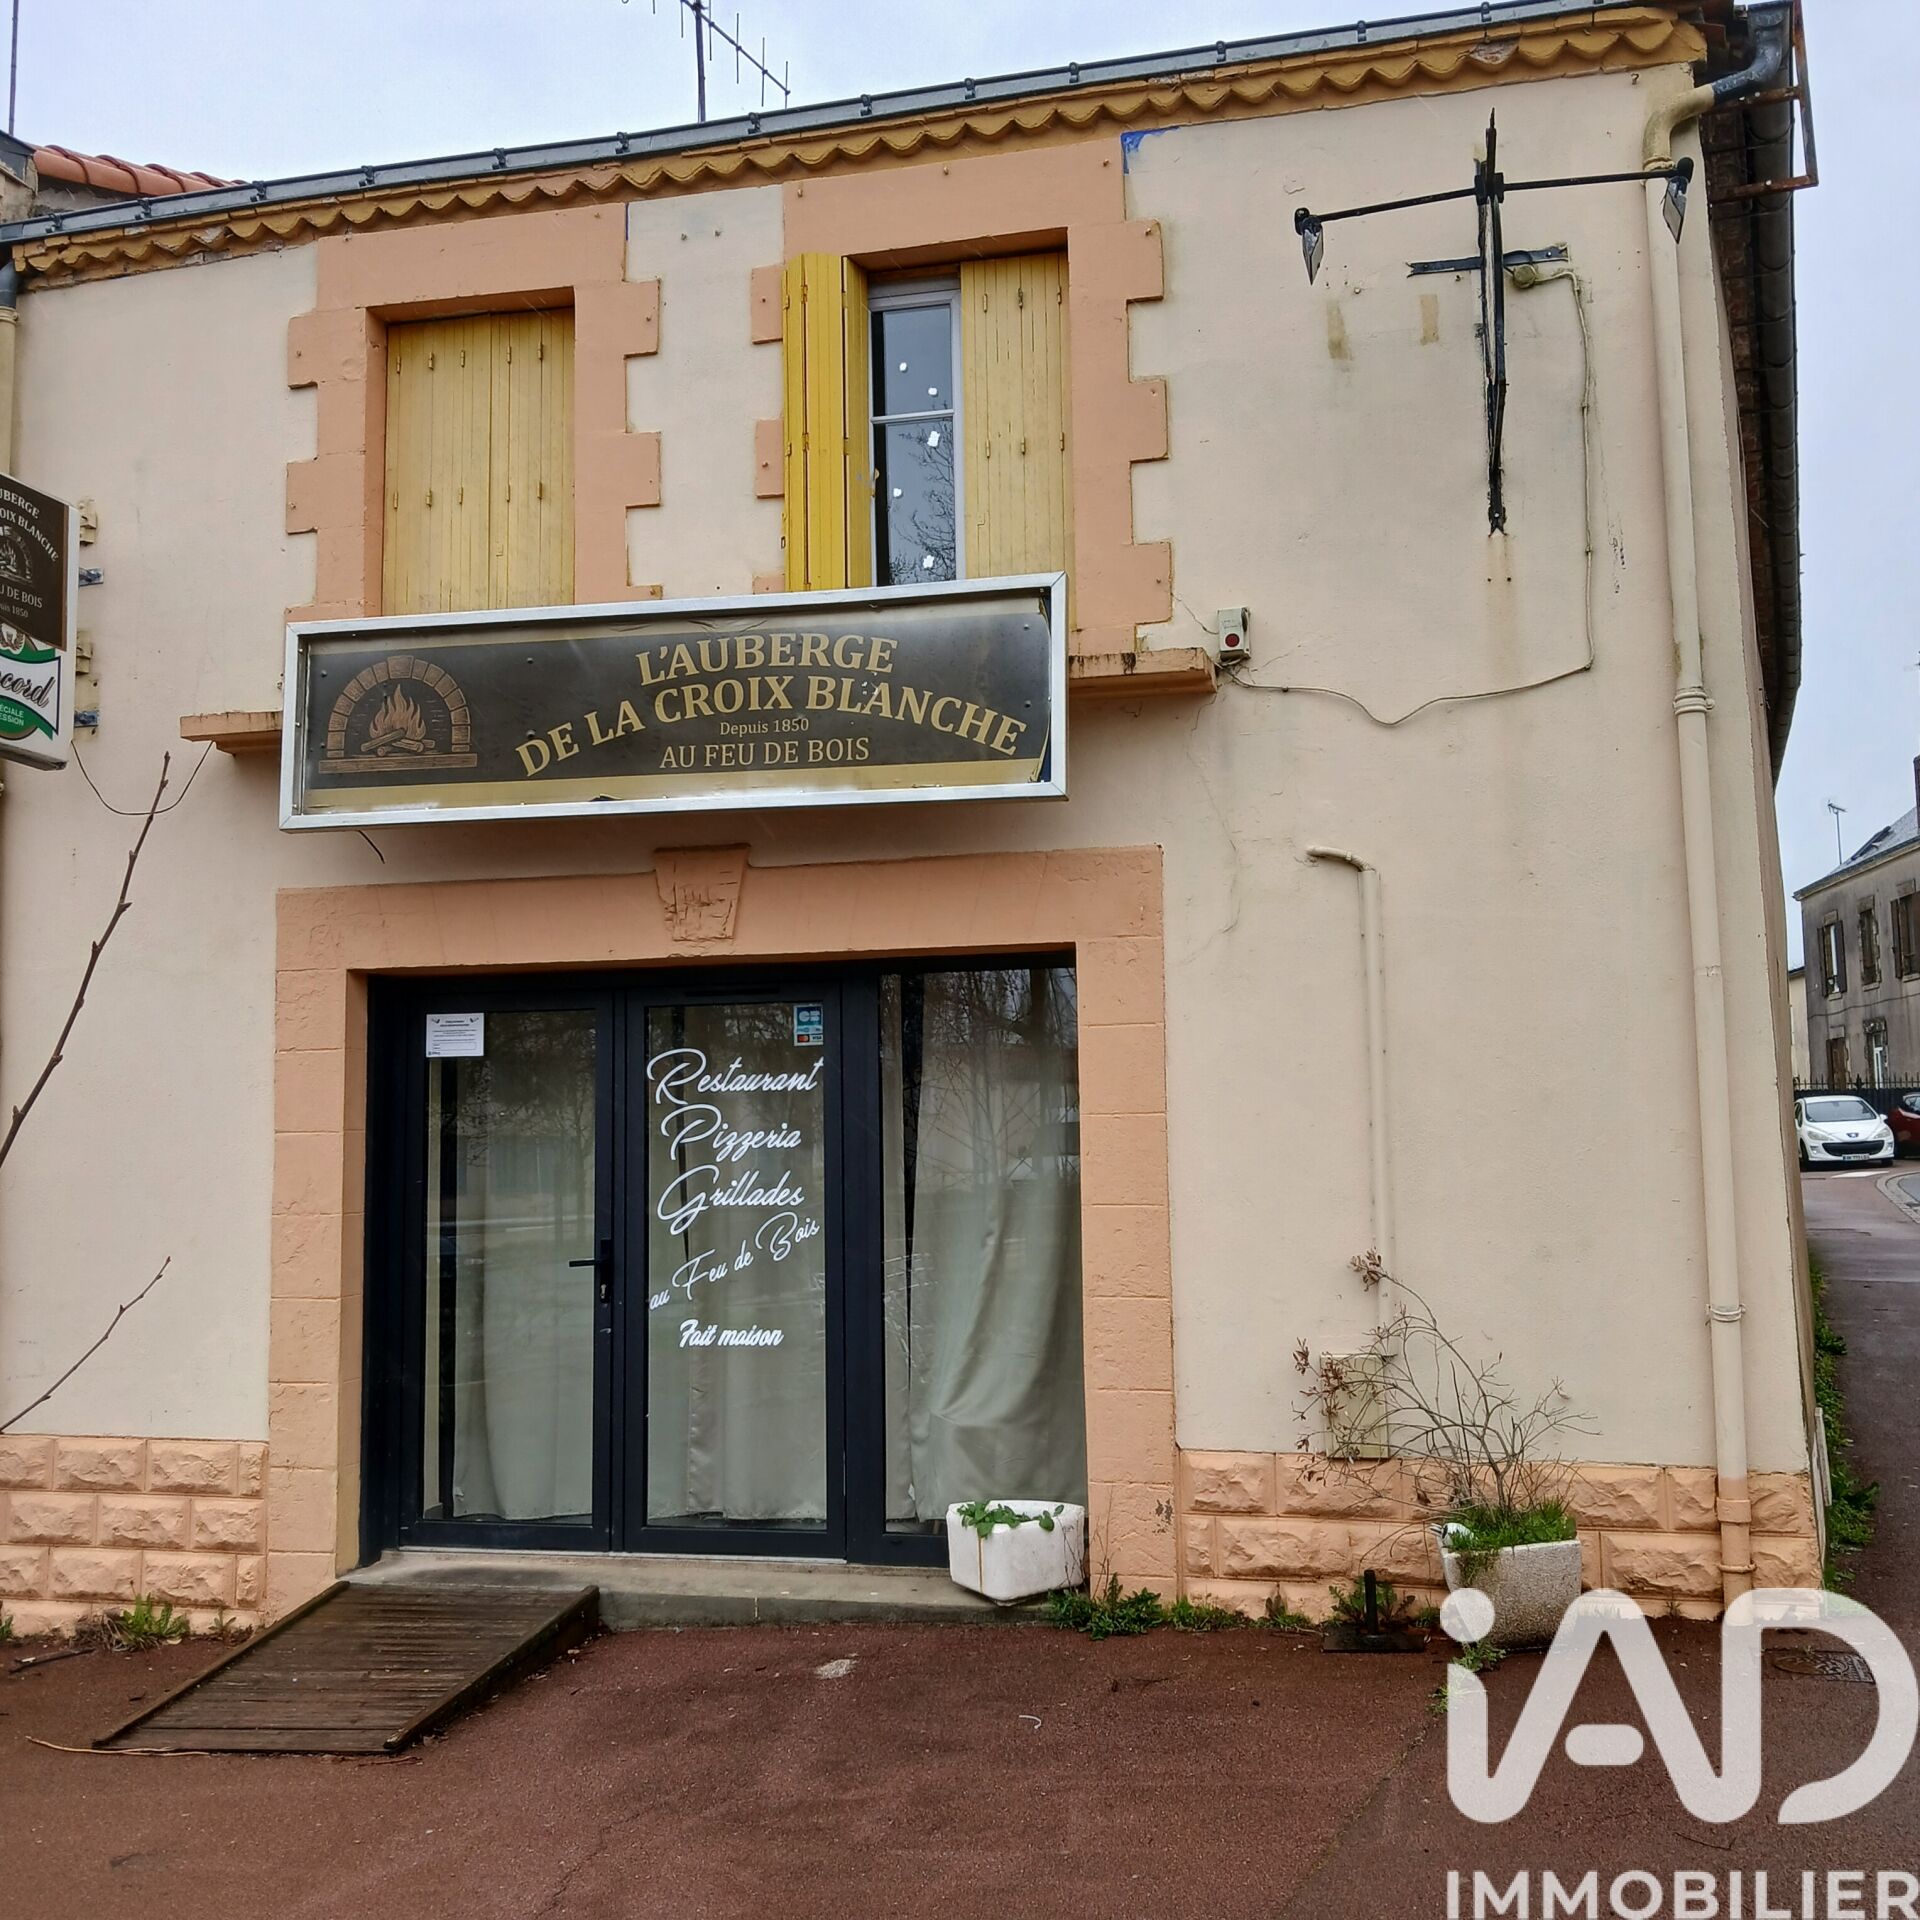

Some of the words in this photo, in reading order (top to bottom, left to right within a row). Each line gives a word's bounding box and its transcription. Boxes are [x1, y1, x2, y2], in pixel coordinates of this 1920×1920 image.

[18, 515, 59, 562] BLANCHE
[7, 585, 20, 601] DE
[21, 591, 43, 609] BOIS
[635, 633, 898, 686] L'AUBERGE
[0, 671, 56, 709] cord
[515, 722, 580, 777] DE
[584, 699, 646, 746] LA
[654, 675, 794, 723] CROIX
[805, 675, 1027, 756] BLANCHE
[720, 720, 769, 738] Depuis
[773, 718, 809, 733] 1850
[659, 745, 696, 769] AU
[704, 742, 755, 767] FEU
[764, 740, 799, 765] DE
[808, 737, 870, 763] BOIS
[646, 1048, 824, 1105] Restaurant
[661, 1103, 801, 1162] Pizzeria
[657, 1164, 804, 1236] Grillades
[649, 1288, 670, 1311] au
[672, 1249, 728, 1301] Feu
[734, 1239, 753, 1272] de
[755, 1211, 820, 1262] Bois
[679, 1318, 718, 1349] Fait
[717, 1323, 784, 1348] maison
